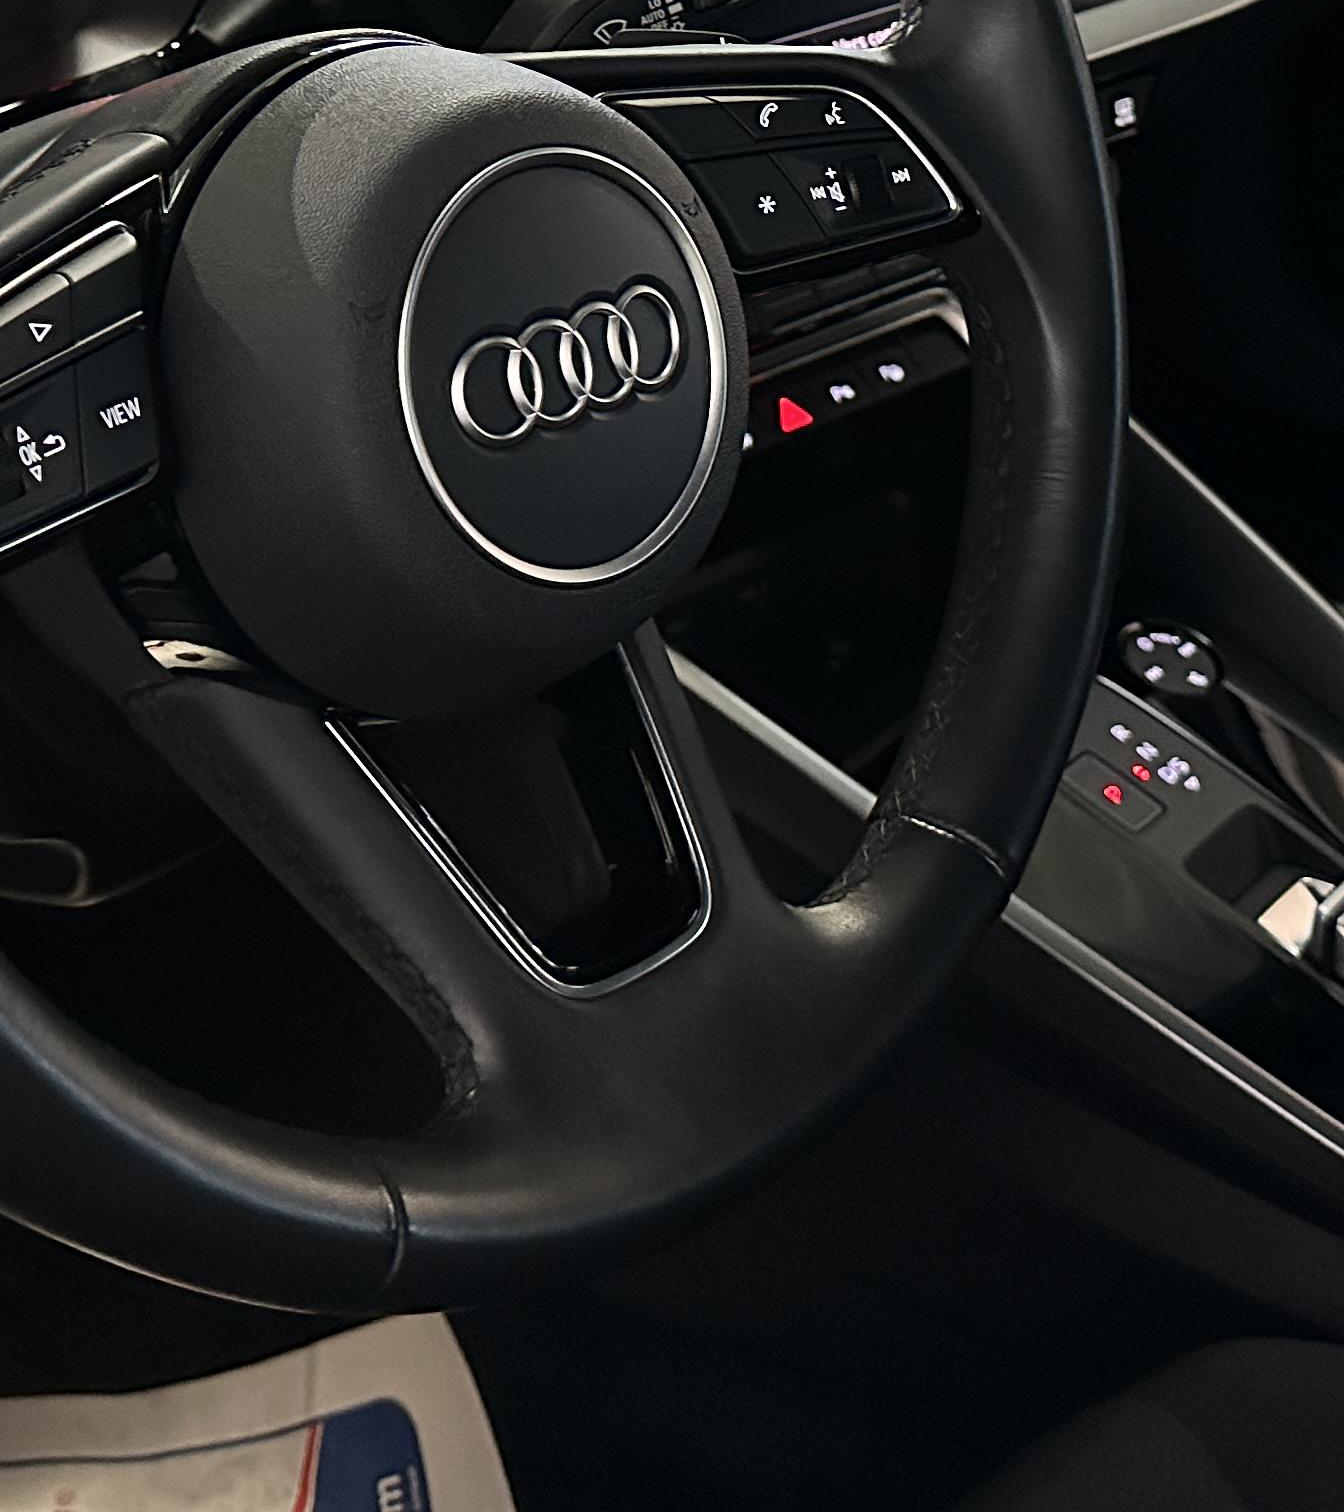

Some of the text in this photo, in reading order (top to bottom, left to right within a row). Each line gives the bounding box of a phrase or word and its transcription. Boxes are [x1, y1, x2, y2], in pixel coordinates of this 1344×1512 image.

[640, 9, 666, 26] AUTO
[100, 397, 141, 428] VIEW
[19, 443, 42, 466] OK
